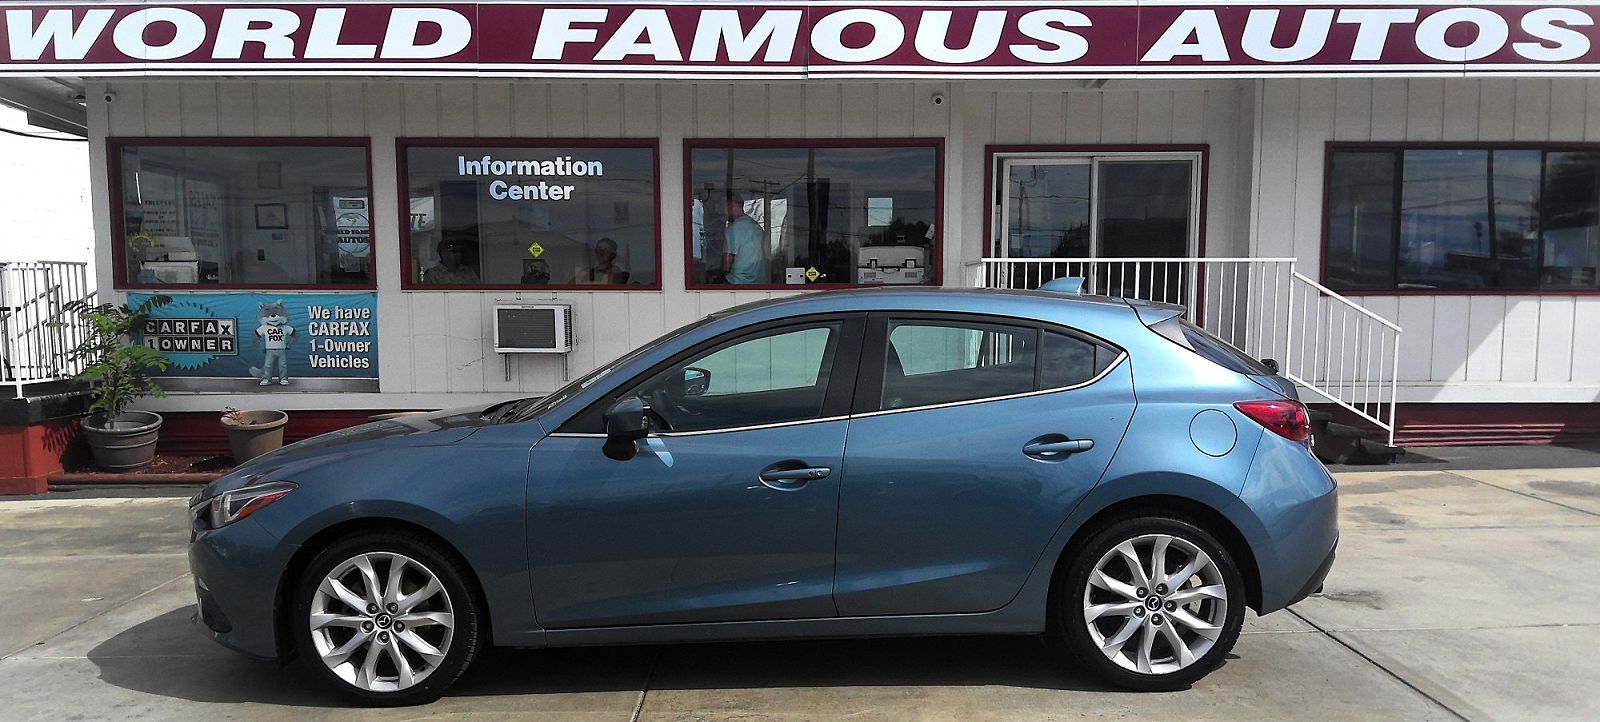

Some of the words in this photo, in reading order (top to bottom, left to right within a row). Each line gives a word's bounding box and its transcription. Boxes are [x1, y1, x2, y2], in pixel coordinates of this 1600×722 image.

[5, 8, 472, 60] WORLD
[531, 8, 1091, 63] FAMOUS
[1140, 8, 1592, 62] AUTOS
[458, 155, 603, 176] Information
[489, 180, 575, 201] Center
[307, 305, 331, 319] We
[335, 305, 371, 319] have
[146, 321, 231, 335] CARFAX
[308, 321, 370, 336] CARFAX
[268, 334, 283, 342] FOX
[309, 338, 371, 352] 1-Owner
[309, 354, 370, 369] Vehicles
